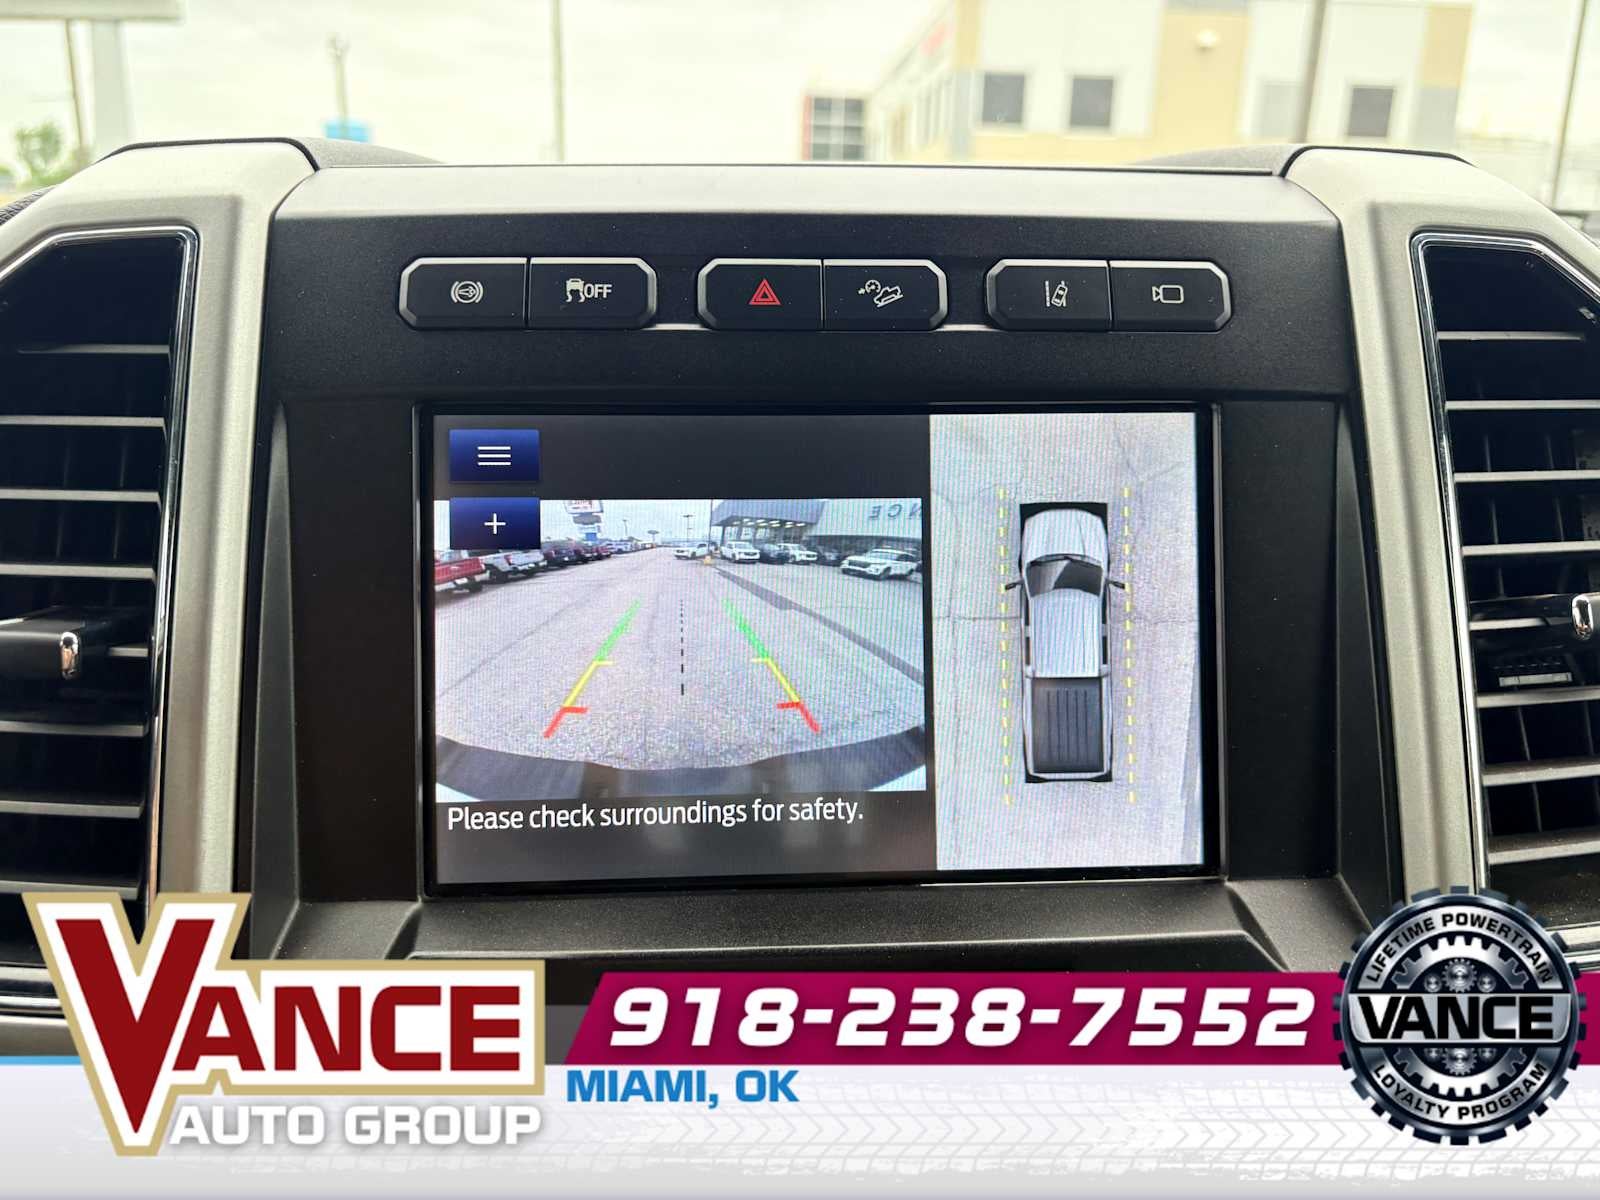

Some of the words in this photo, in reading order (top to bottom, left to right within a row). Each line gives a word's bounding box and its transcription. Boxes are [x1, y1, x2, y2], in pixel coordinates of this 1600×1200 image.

[584, 283, 612, 298] OFF
[448, 807, 524, 830] Please
[529, 804, 595, 828] check
[599, 800, 747, 828] surroundings
[752, 799, 784, 821] for
[789, 797, 864, 824] safety.
